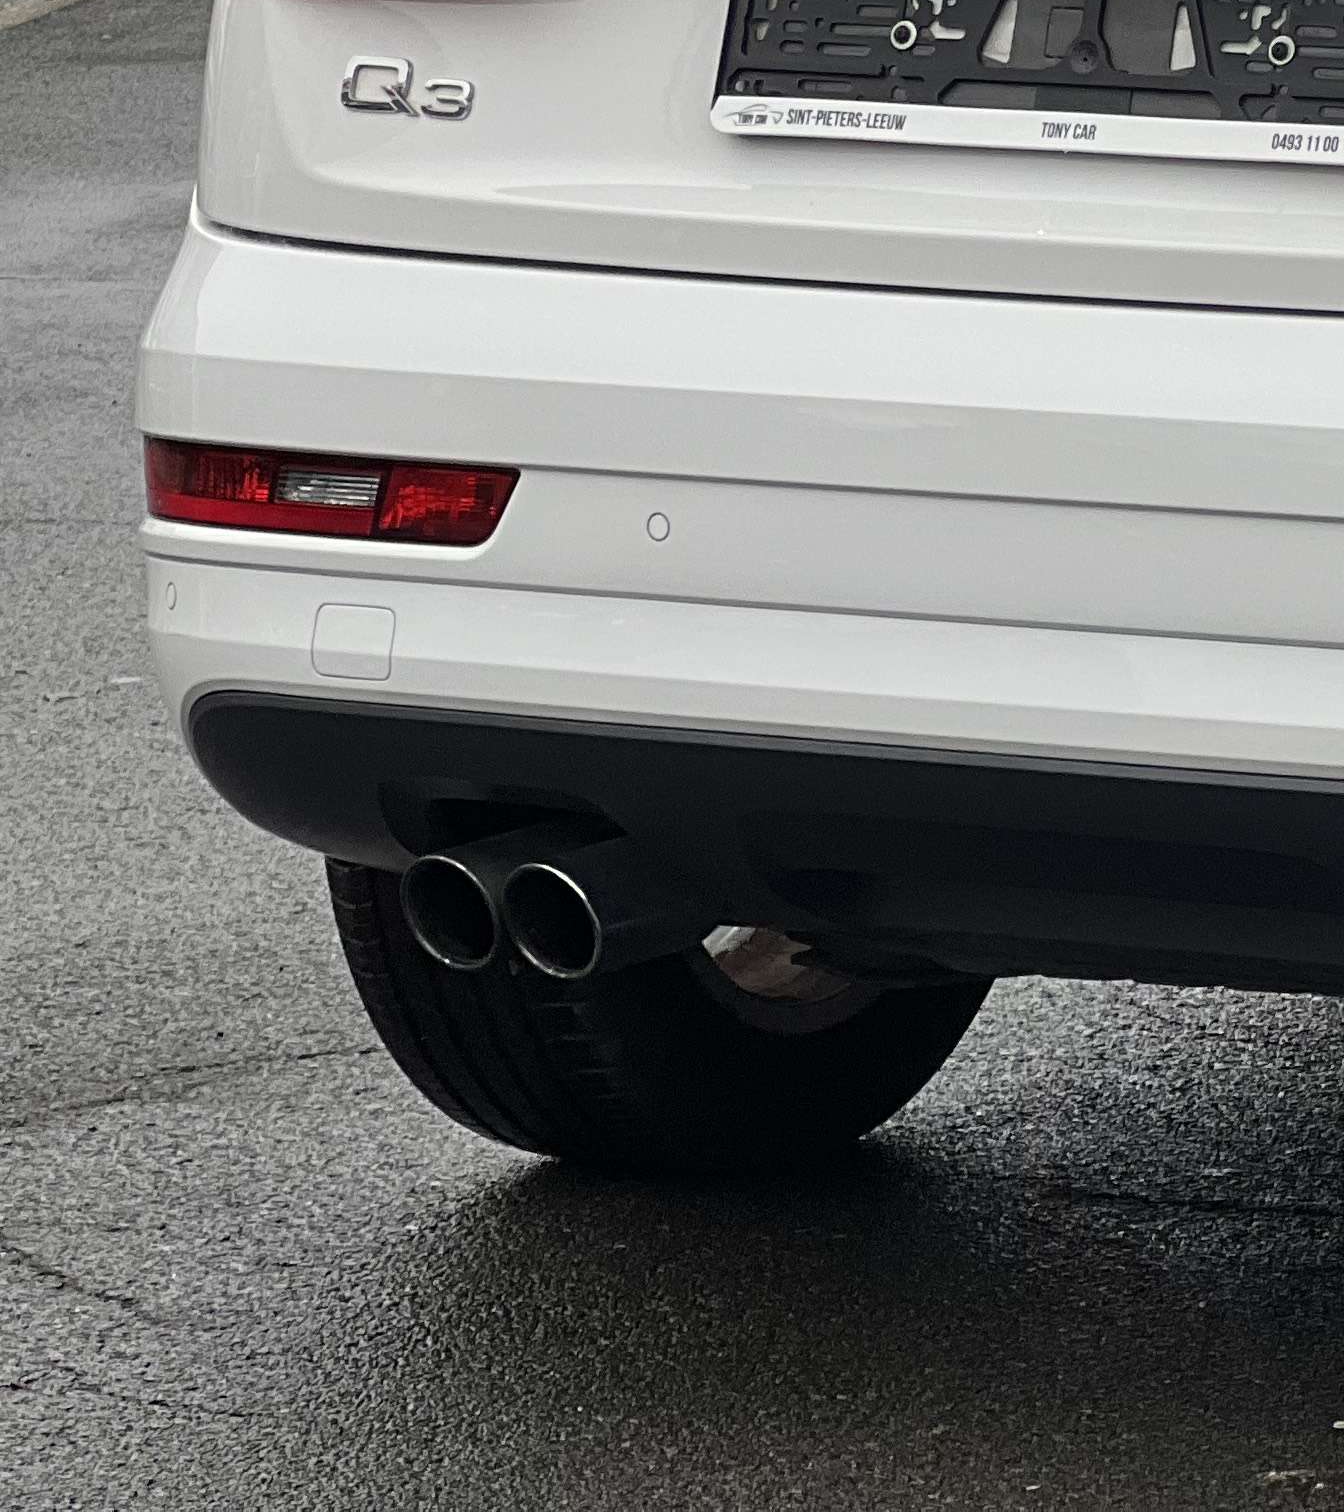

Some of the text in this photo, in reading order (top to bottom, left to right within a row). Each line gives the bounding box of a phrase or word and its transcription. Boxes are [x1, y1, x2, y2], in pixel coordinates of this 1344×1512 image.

[340, 55, 476, 121] Q3
[786, 108, 907, 130] SINT-PIETERS-LEEUW
[1041, 122, 1097, 140] TONY CAR
[1271, 133, 1303, 150] 0493
